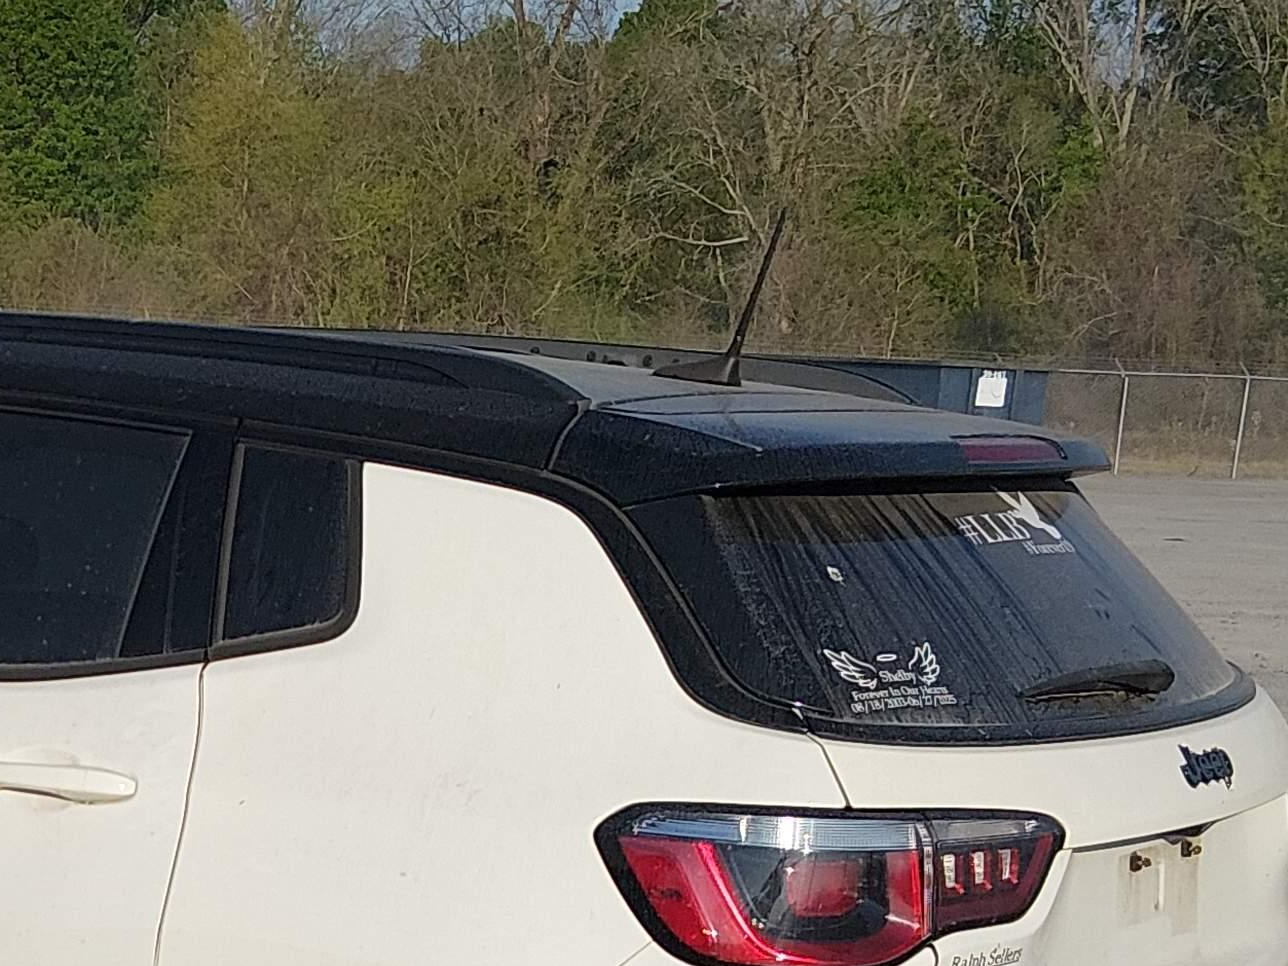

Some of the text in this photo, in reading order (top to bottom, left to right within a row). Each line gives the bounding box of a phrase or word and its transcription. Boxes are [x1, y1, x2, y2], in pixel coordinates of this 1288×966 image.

[879, 669, 916, 685] Shelby
[852, 689, 889, 701] Forever
[900, 685, 919, 695] Our
[1178, 744, 1234, 790] Jeep
[987, 945, 1023, 966] Sellers
